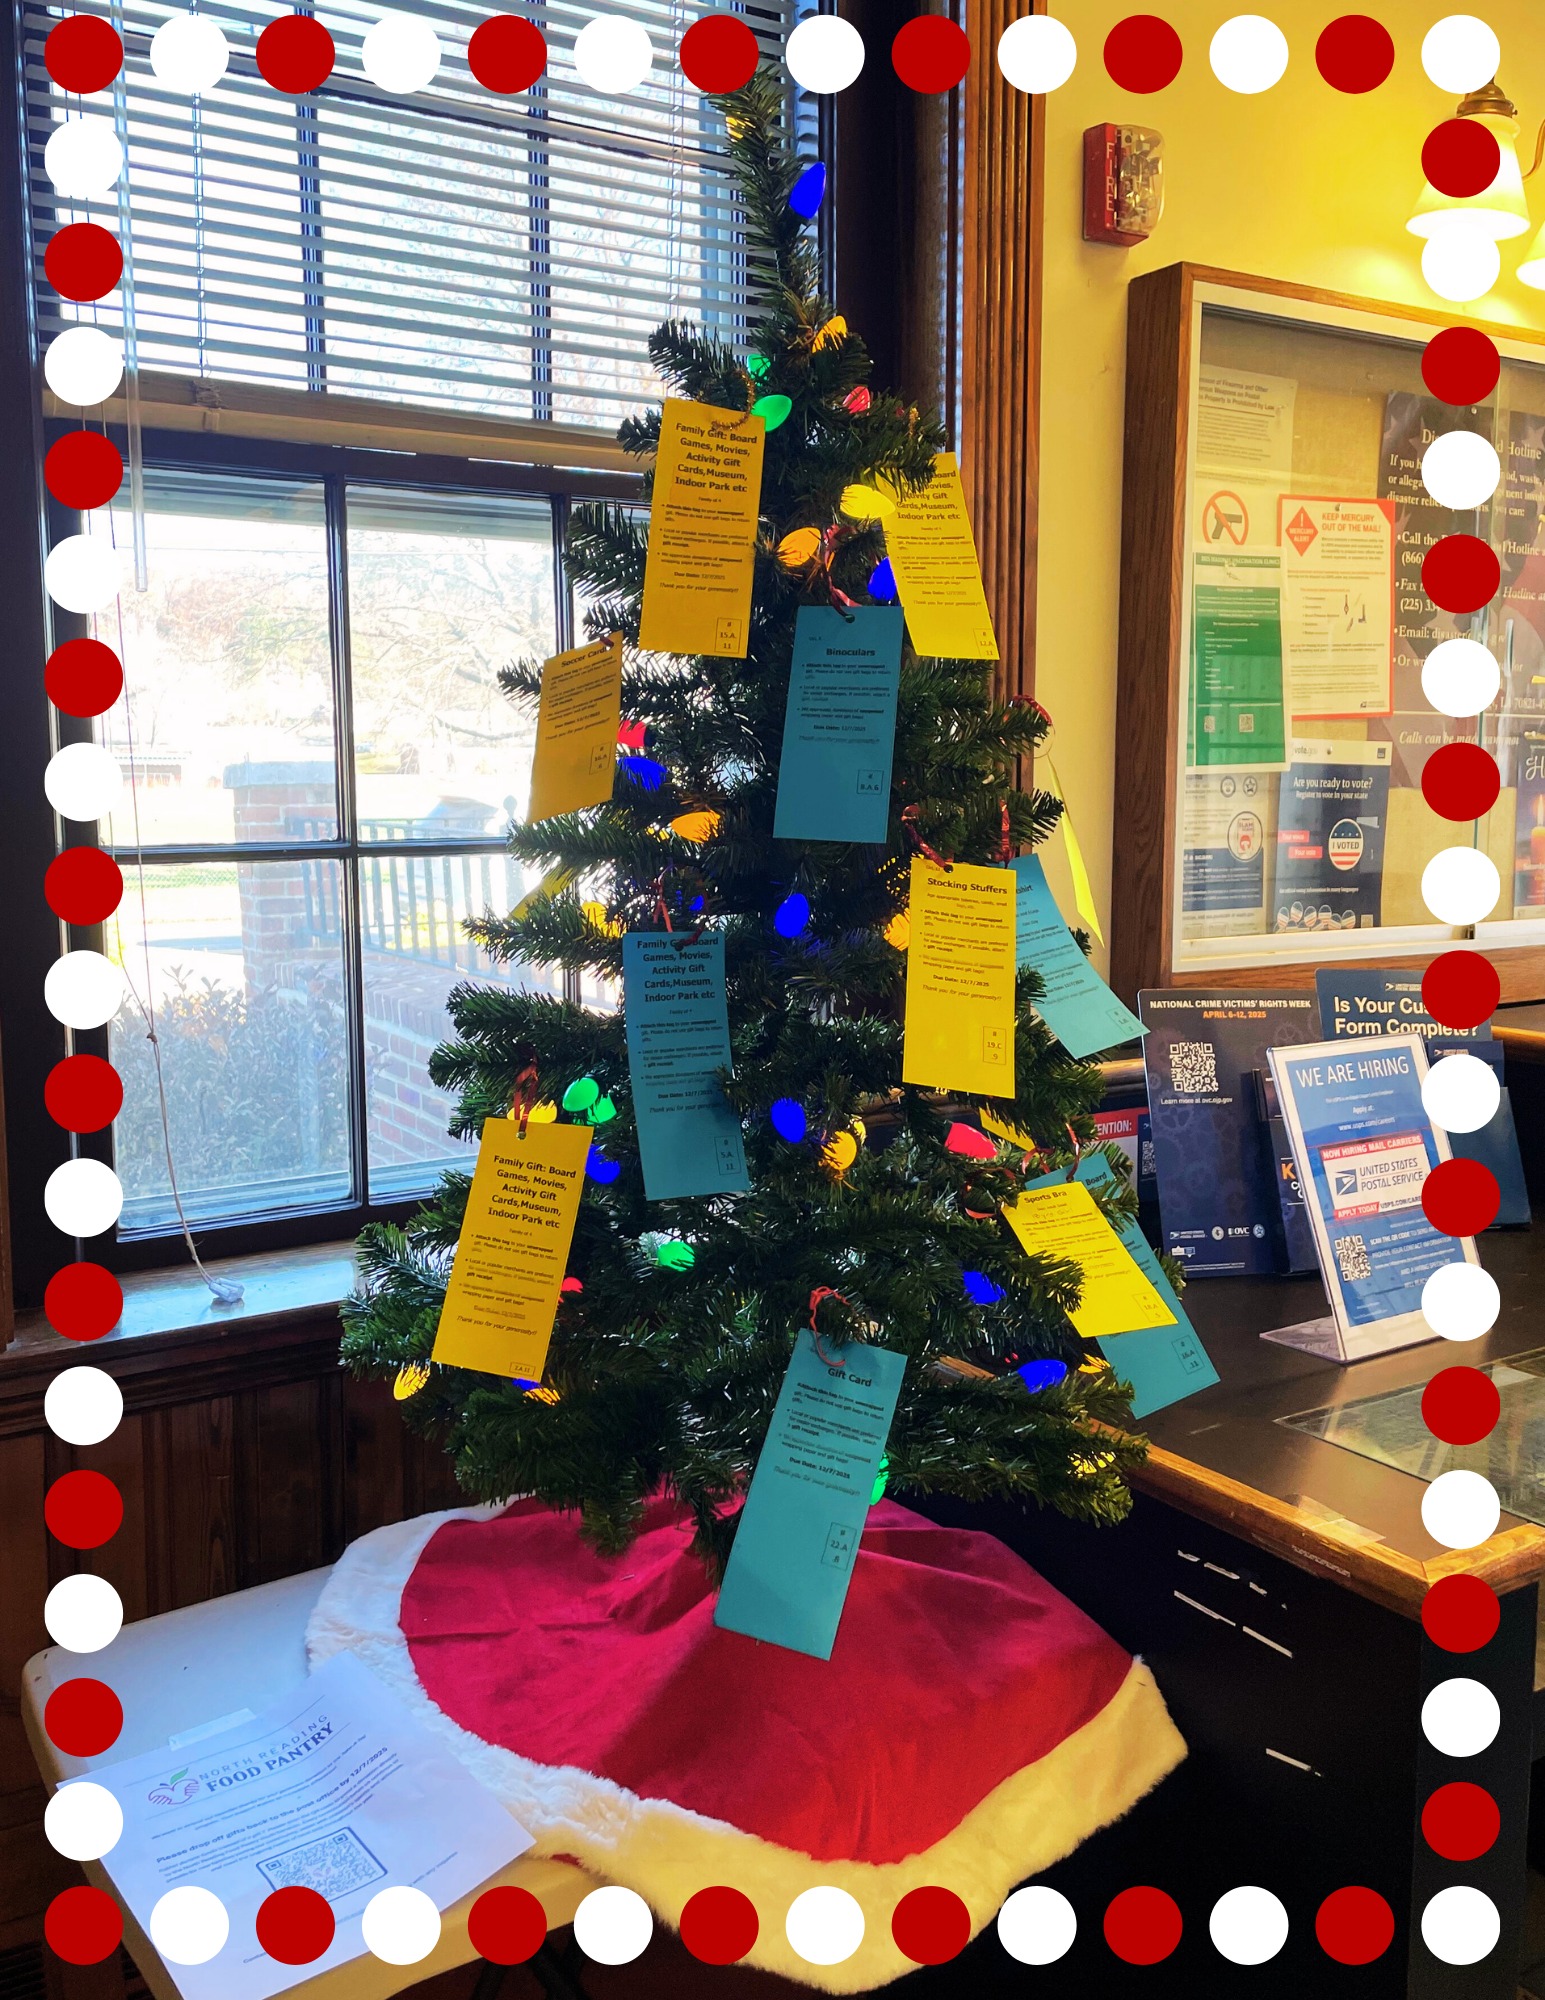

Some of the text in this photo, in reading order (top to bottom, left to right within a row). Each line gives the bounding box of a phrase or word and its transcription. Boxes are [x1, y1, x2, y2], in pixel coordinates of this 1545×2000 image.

[1107, 142, 1116, 211] FIRE
[676, 423, 758, 444] Family Gift: Board
[680, 437, 750, 457] Games, Movies,
[686, 452, 741, 467] Activity Gift
[1390, 454, 1414, 470] If you
[674, 476, 748, 492] Indoor Park etc
[1388, 476, 1398, 484] or
[932, 492, 948, 500] Gift
[1387, 490, 1418, 506] disaster
[898, 512, 924, 520] Indoor
[1322, 512, 1375, 522] KEEP MERCURY
[1322, 523, 1338, 531] OUT
[1340, 524, 1350, 532] OF
[1351, 524, 1362, 532] THE
[1401, 531, 1421, 545] Call
[1508, 541, 1540, 556] Hotline
[1400, 579, 1416, 591] Fax
[1502, 586, 1536, 600] Hotline
[1400, 598, 1423, 614] (225)
[1398, 624, 1430, 640] Email:
[826, 648, 876, 657] Binoculars
[561, 654, 586, 668] Soccer
[1397, 654, 1410, 667] Or
[1400, 731, 1454, 744] Calls can be
[1293, 777, 1373, 791] Are you ready to vote?
[1296, 790, 1316, 800] Register
[1340, 793, 1354, 802] your
[1354, 792, 1368, 800] state
[1336, 842, 1360, 850] VOTED
[927, 878, 1008, 895] Stocking Stuffers
[637, 940, 668, 950] Family
[643, 950, 713, 962] Games, Movies,
[652, 964, 706, 975] Activity Gift
[960, 978, 990, 987] 12/7/2025
[644, 990, 716, 1003] Indoor Park etc
[1150, 1000, 1312, 1009] NATIONAL CRIME VICTIMS' RIGHTS WEEK
[1334, 996, 1350, 1014] Is
[1354, 997, 1394, 1014] Your
[1203, 1010, 1268, 1020] APRIL 6-12, 2025
[1335, 1018, 1382, 1034] Form
[1296, 1056, 1410, 1088] WE ARE HIRING
[1352, 1106, 1366, 1115] Apply
[1097, 1120, 1132, 1136] ENTION:
[1322, 1135, 1422, 1159] NOW HIRING MAIL CARRIERS
[494, 1154, 576, 1178] Family Gift: Board
[1360, 1158, 1418, 1178] UNITED STATES
[496, 1169, 568, 1191] Games, Movies,
[1086, 1172, 1108, 1186] Board
[1361, 1171, 1425, 1192] POSTAL SERVICE
[502, 1183, 557, 1201] Activity Gift
[1024, 1194, 1052, 1204] Sports
[1338, 1196, 1422, 1218] APPLY TODAY USPS.COM/CARE
[488, 1207, 560, 1229] Indoor Park etc
[1234, 1227, 1250, 1235] OVC
[1370, 1238, 1382, 1246] SCAN
[1391, 1234, 1398, 1242] QR
[1398, 1232, 1410, 1240] CODE
[457, 1315, 506, 1332] Thank you for your
[828, 1368, 872, 1388] Gift Card
[790, 1456, 850, 1480] Due Date: 12/7/2025
[199, 1715, 328, 1780] NORTH READING
[206, 1722, 334, 1792] FOOD PANTRY
[156, 1850, 188, 1863] Please
[189, 1842, 210, 1856] drop
[212, 1834, 224, 1844] off
[226, 1830, 246, 1842] gifts
[246, 1818, 268, 1830] back
[296, 1801, 315, 1812] post
[316, 1786, 340, 1802] office
[340, 1777, 350, 1788] by
[350, 1746, 388, 1778] 12/7/2025
